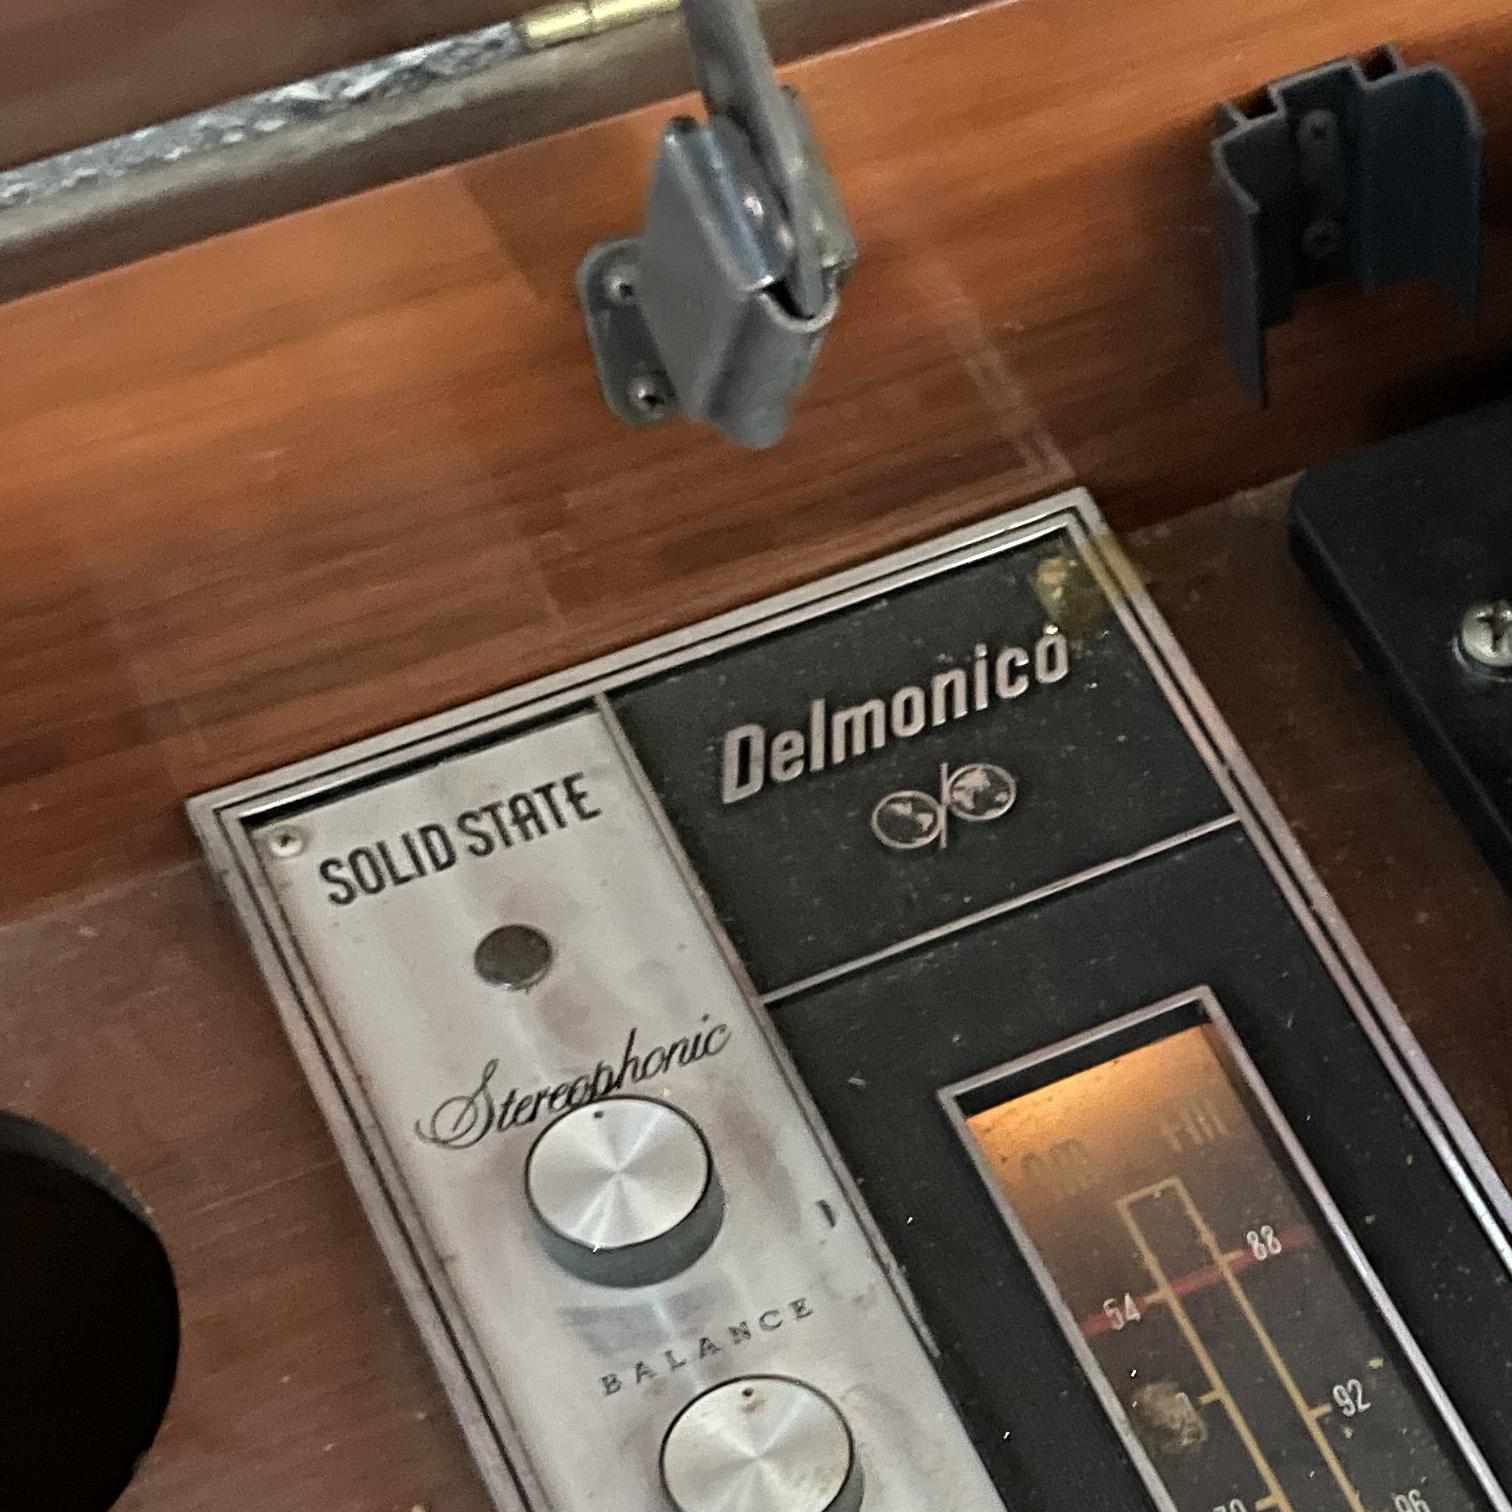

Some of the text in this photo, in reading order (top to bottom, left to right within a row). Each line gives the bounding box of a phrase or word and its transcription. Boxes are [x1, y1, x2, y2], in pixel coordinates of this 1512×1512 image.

[720, 634, 1072, 805] Delmonico
[318, 771, 603, 909] SOLID STATE
[415, 1012, 732, 1150] Stereophonic
[600, 1297, 815, 1398] BALANCE
[1332, 1378, 1373, 1418] 92
